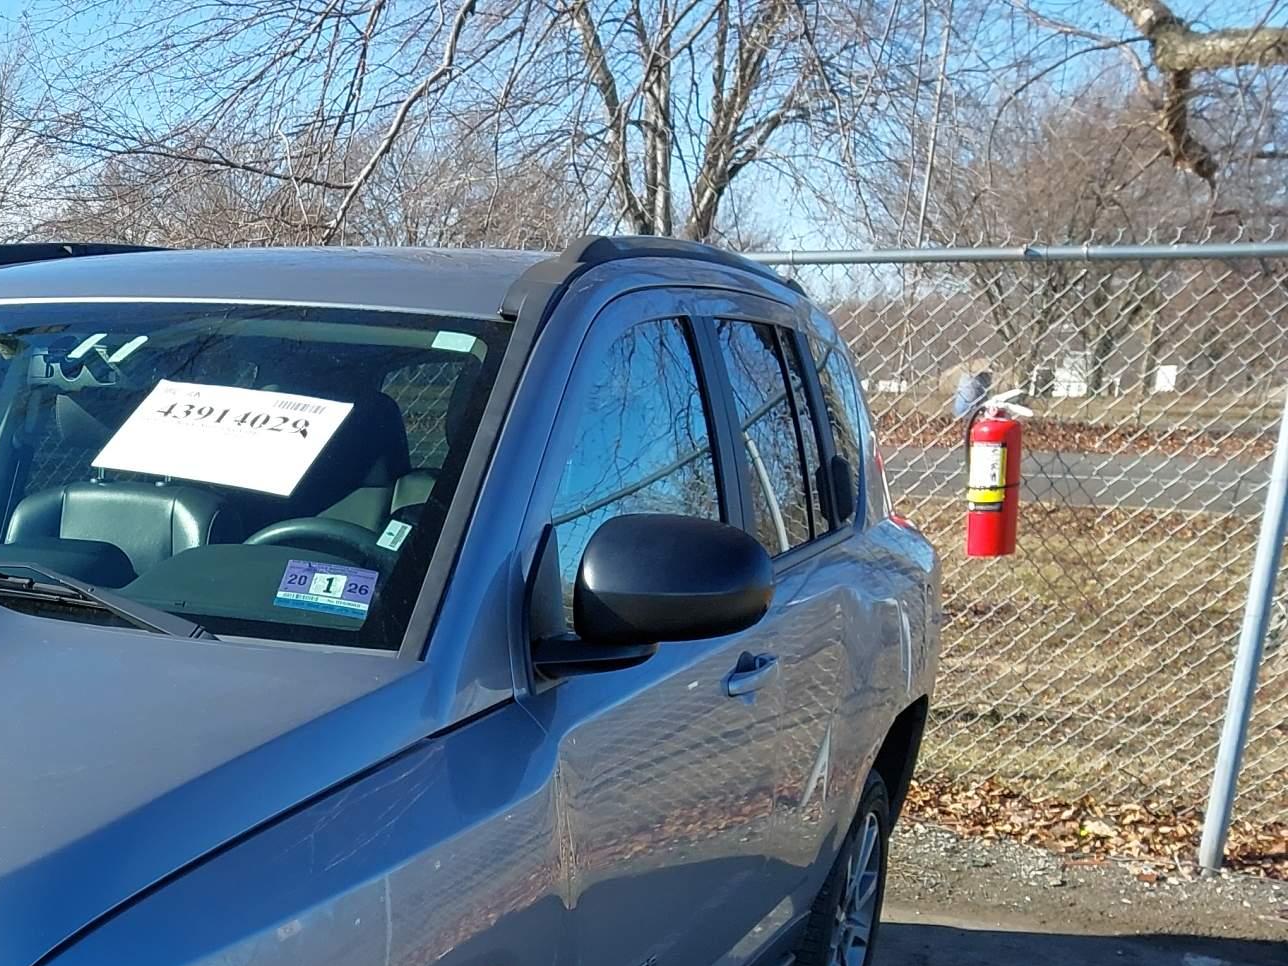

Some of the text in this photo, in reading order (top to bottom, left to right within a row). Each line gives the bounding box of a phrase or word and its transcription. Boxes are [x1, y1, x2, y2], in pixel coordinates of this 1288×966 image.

[156, 402, 310, 439] 43914029
[287, 574, 369, 596] 20 1 26
